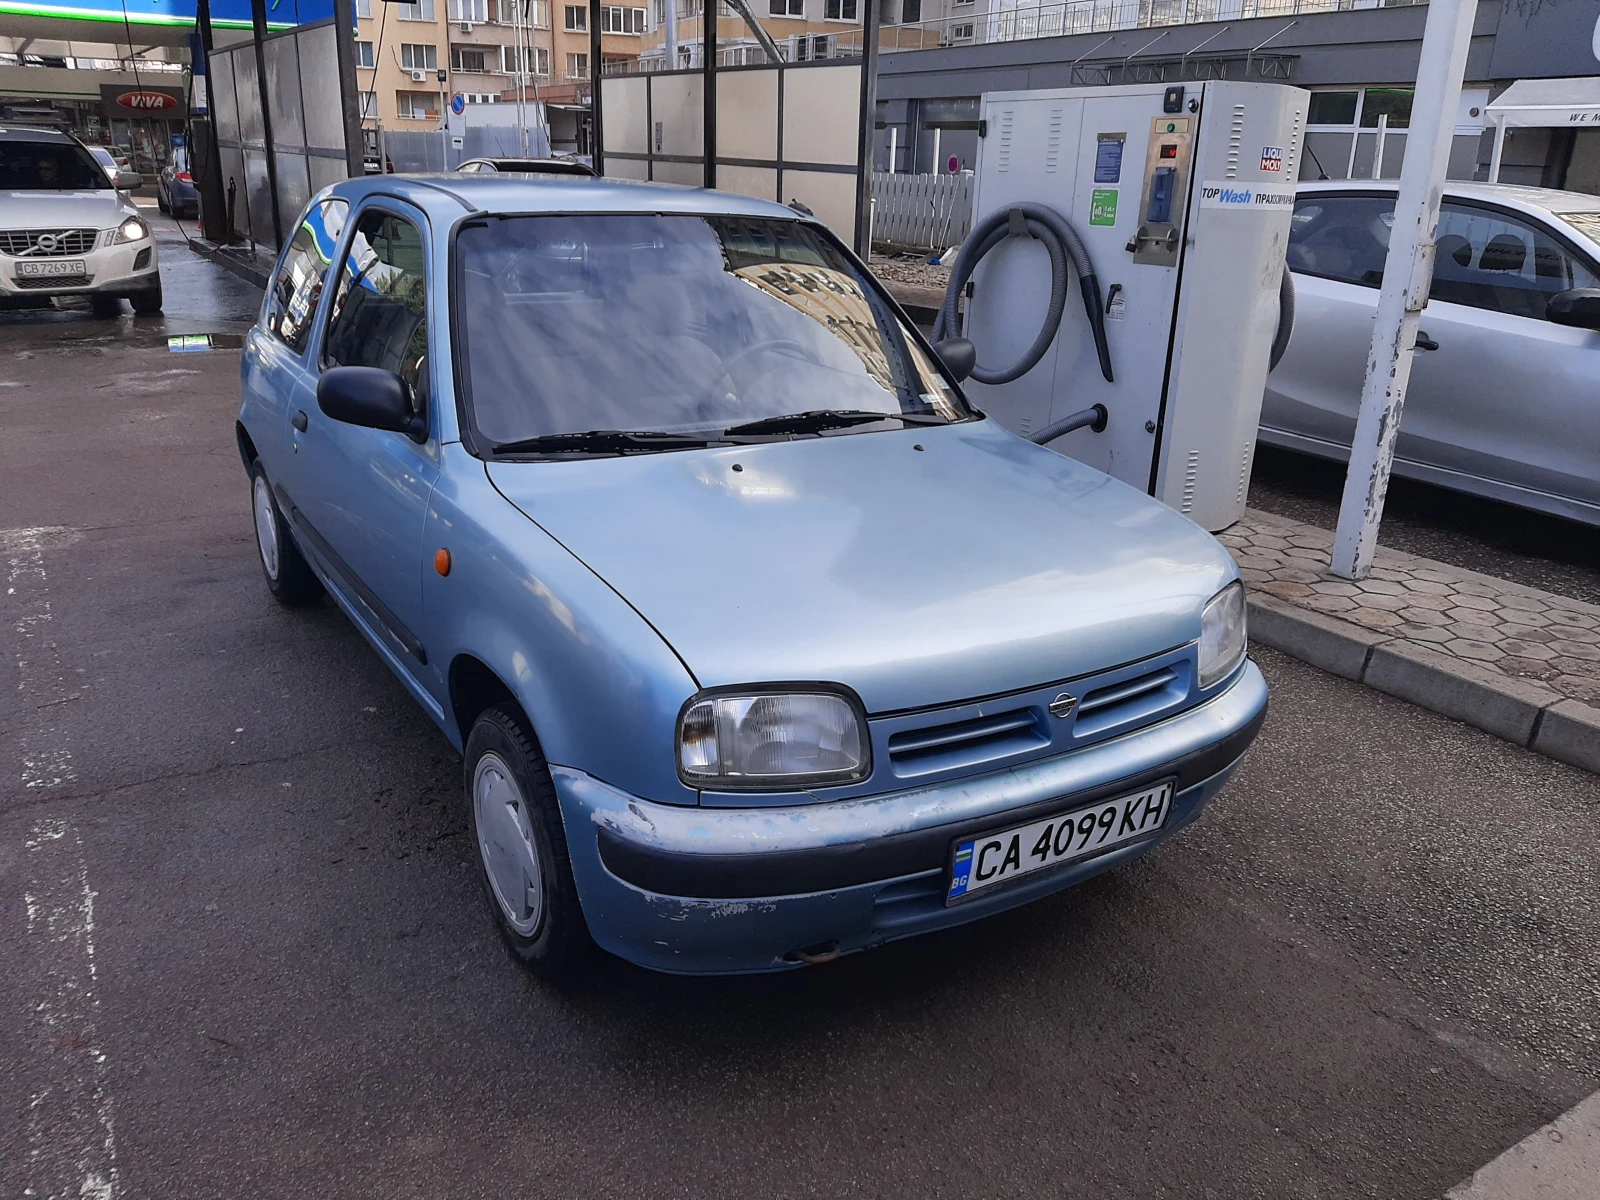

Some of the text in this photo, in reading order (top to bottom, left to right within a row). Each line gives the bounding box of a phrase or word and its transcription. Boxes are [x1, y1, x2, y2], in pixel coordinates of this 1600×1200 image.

[1569, 113, 1588, 121] WE
[1261, 159, 1281, 170] MOLY
[24, 262, 83, 274] CB 7269 XE
[975, 789, 1167, 882] CA 4099 KH
[951, 874, 967, 890] BG
